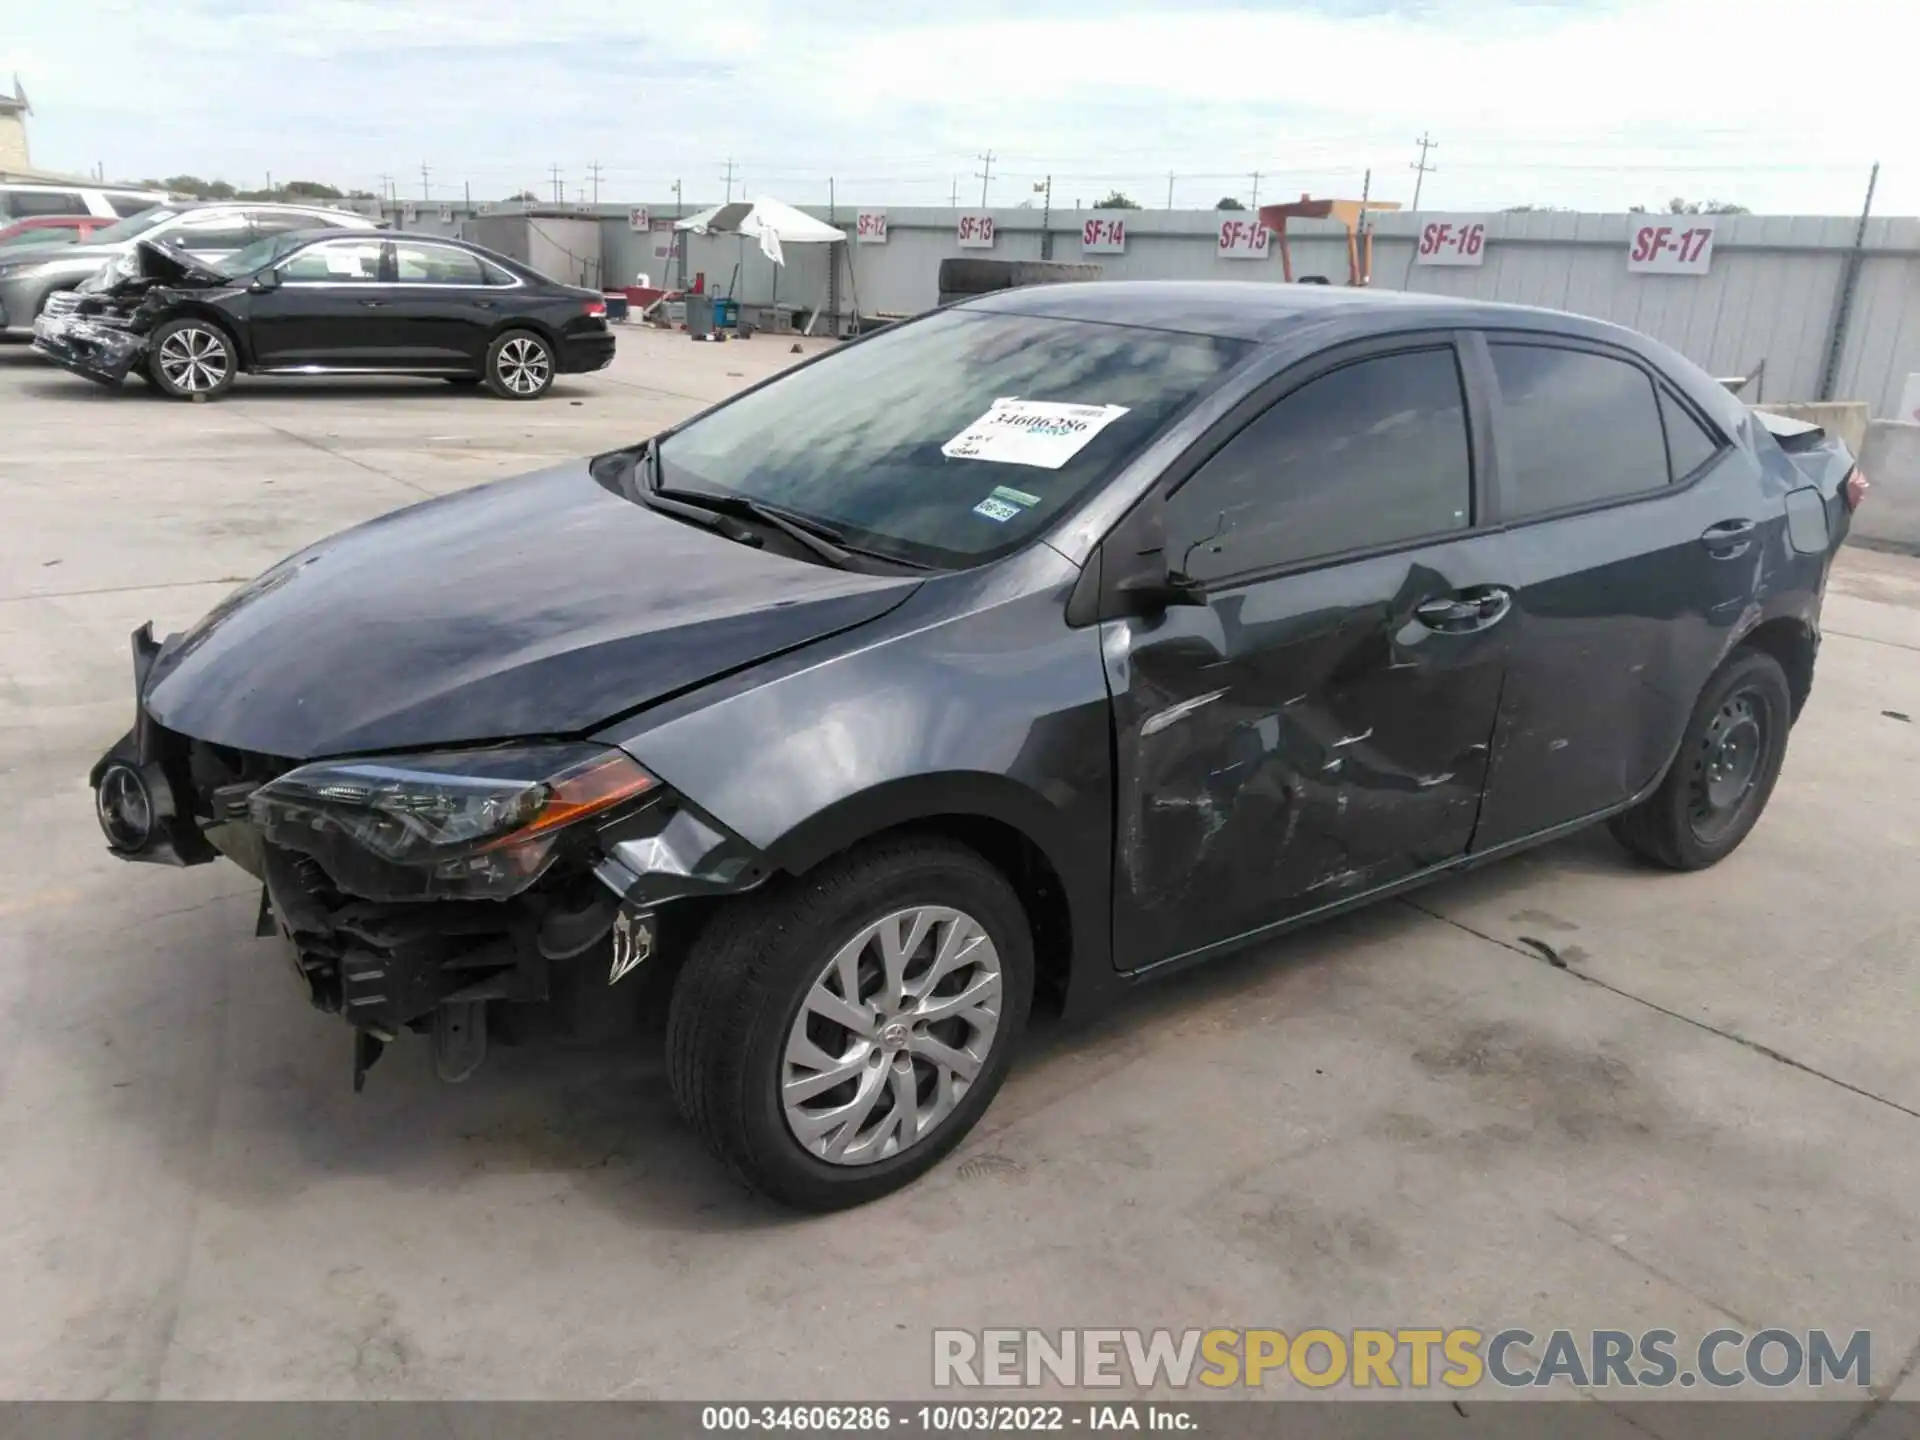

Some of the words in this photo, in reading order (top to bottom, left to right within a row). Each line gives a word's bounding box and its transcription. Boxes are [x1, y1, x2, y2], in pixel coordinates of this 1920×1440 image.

[858, 215, 886, 236] SF-12
[959, 216, 993, 241] SF-13
[1084, 219, 1124, 245] SF-14
[1220, 221, 1268, 249] SF-15
[1420, 223, 1485, 255] SF-16
[1631, 227, 1713, 262] SF-17
